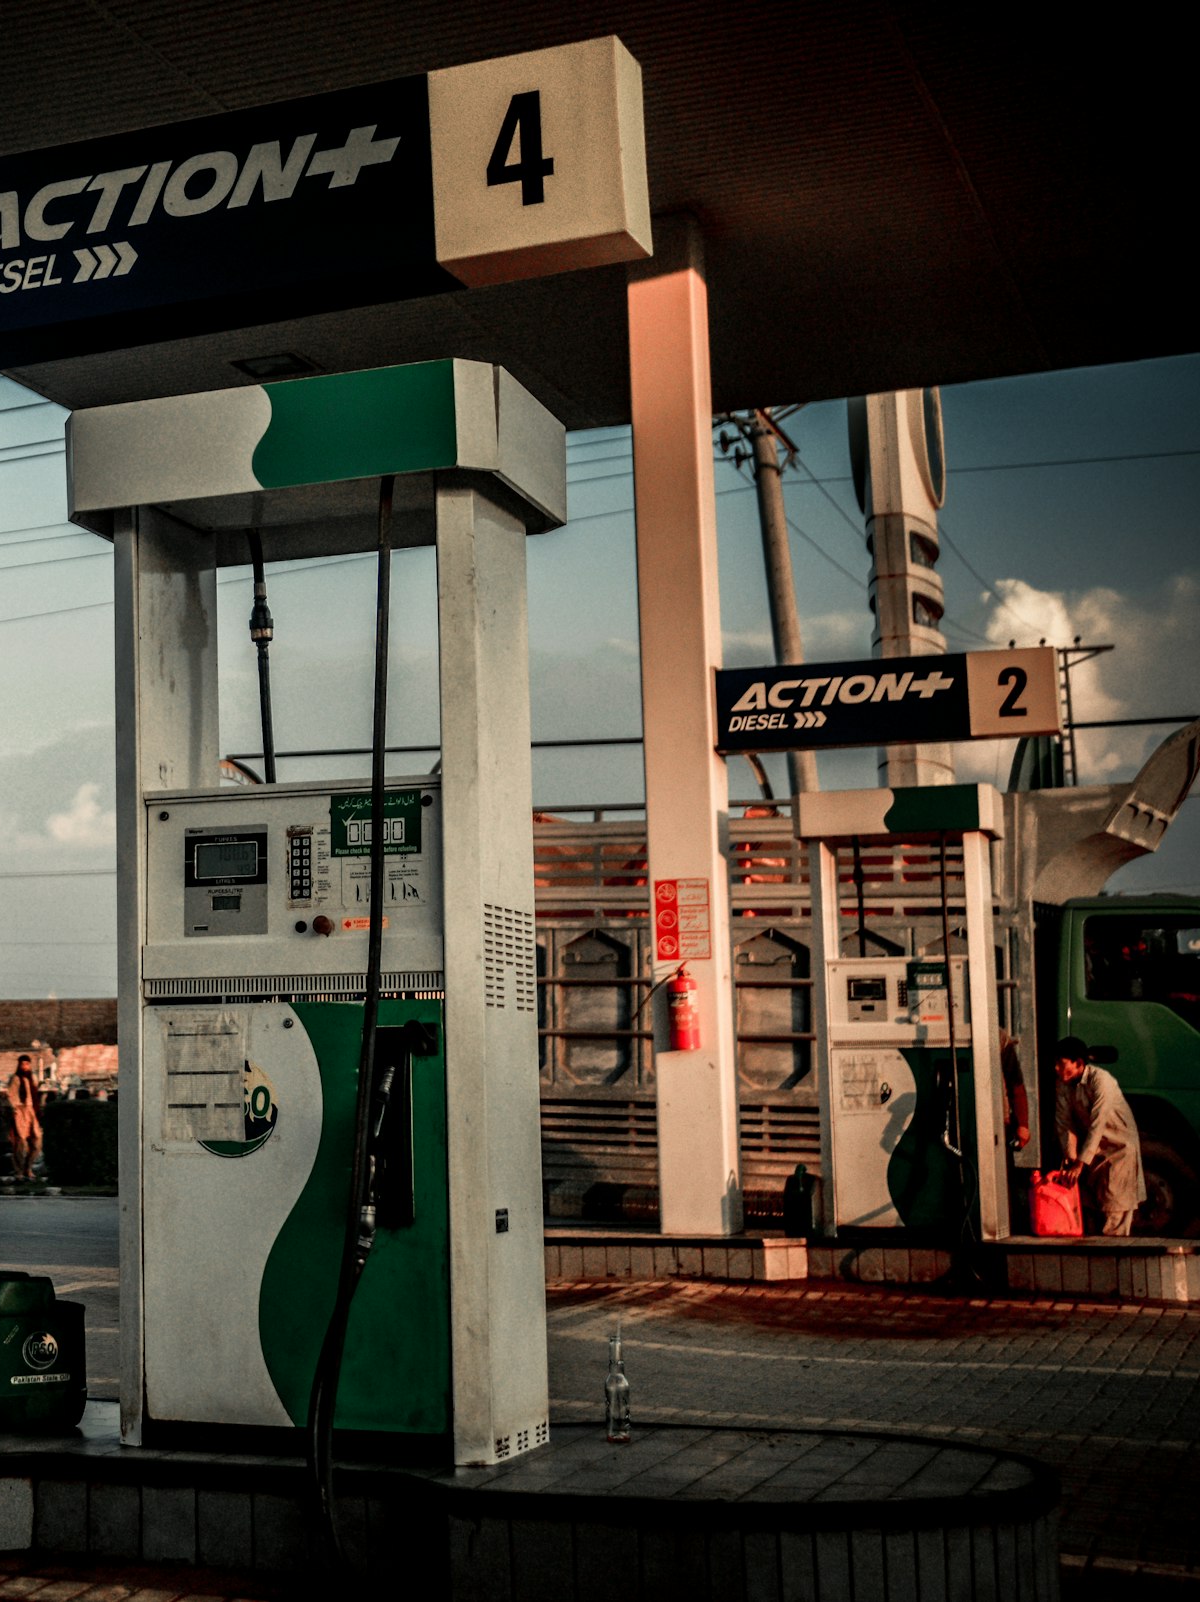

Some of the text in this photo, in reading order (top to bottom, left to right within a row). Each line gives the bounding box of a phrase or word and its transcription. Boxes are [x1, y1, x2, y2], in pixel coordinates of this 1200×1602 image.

[486, 89, 554, 207] 4
[997, 666, 1028, 718] 2
[728, 713, 789, 733] DIESEL
[32, 1341, 54, 1355] PSO
